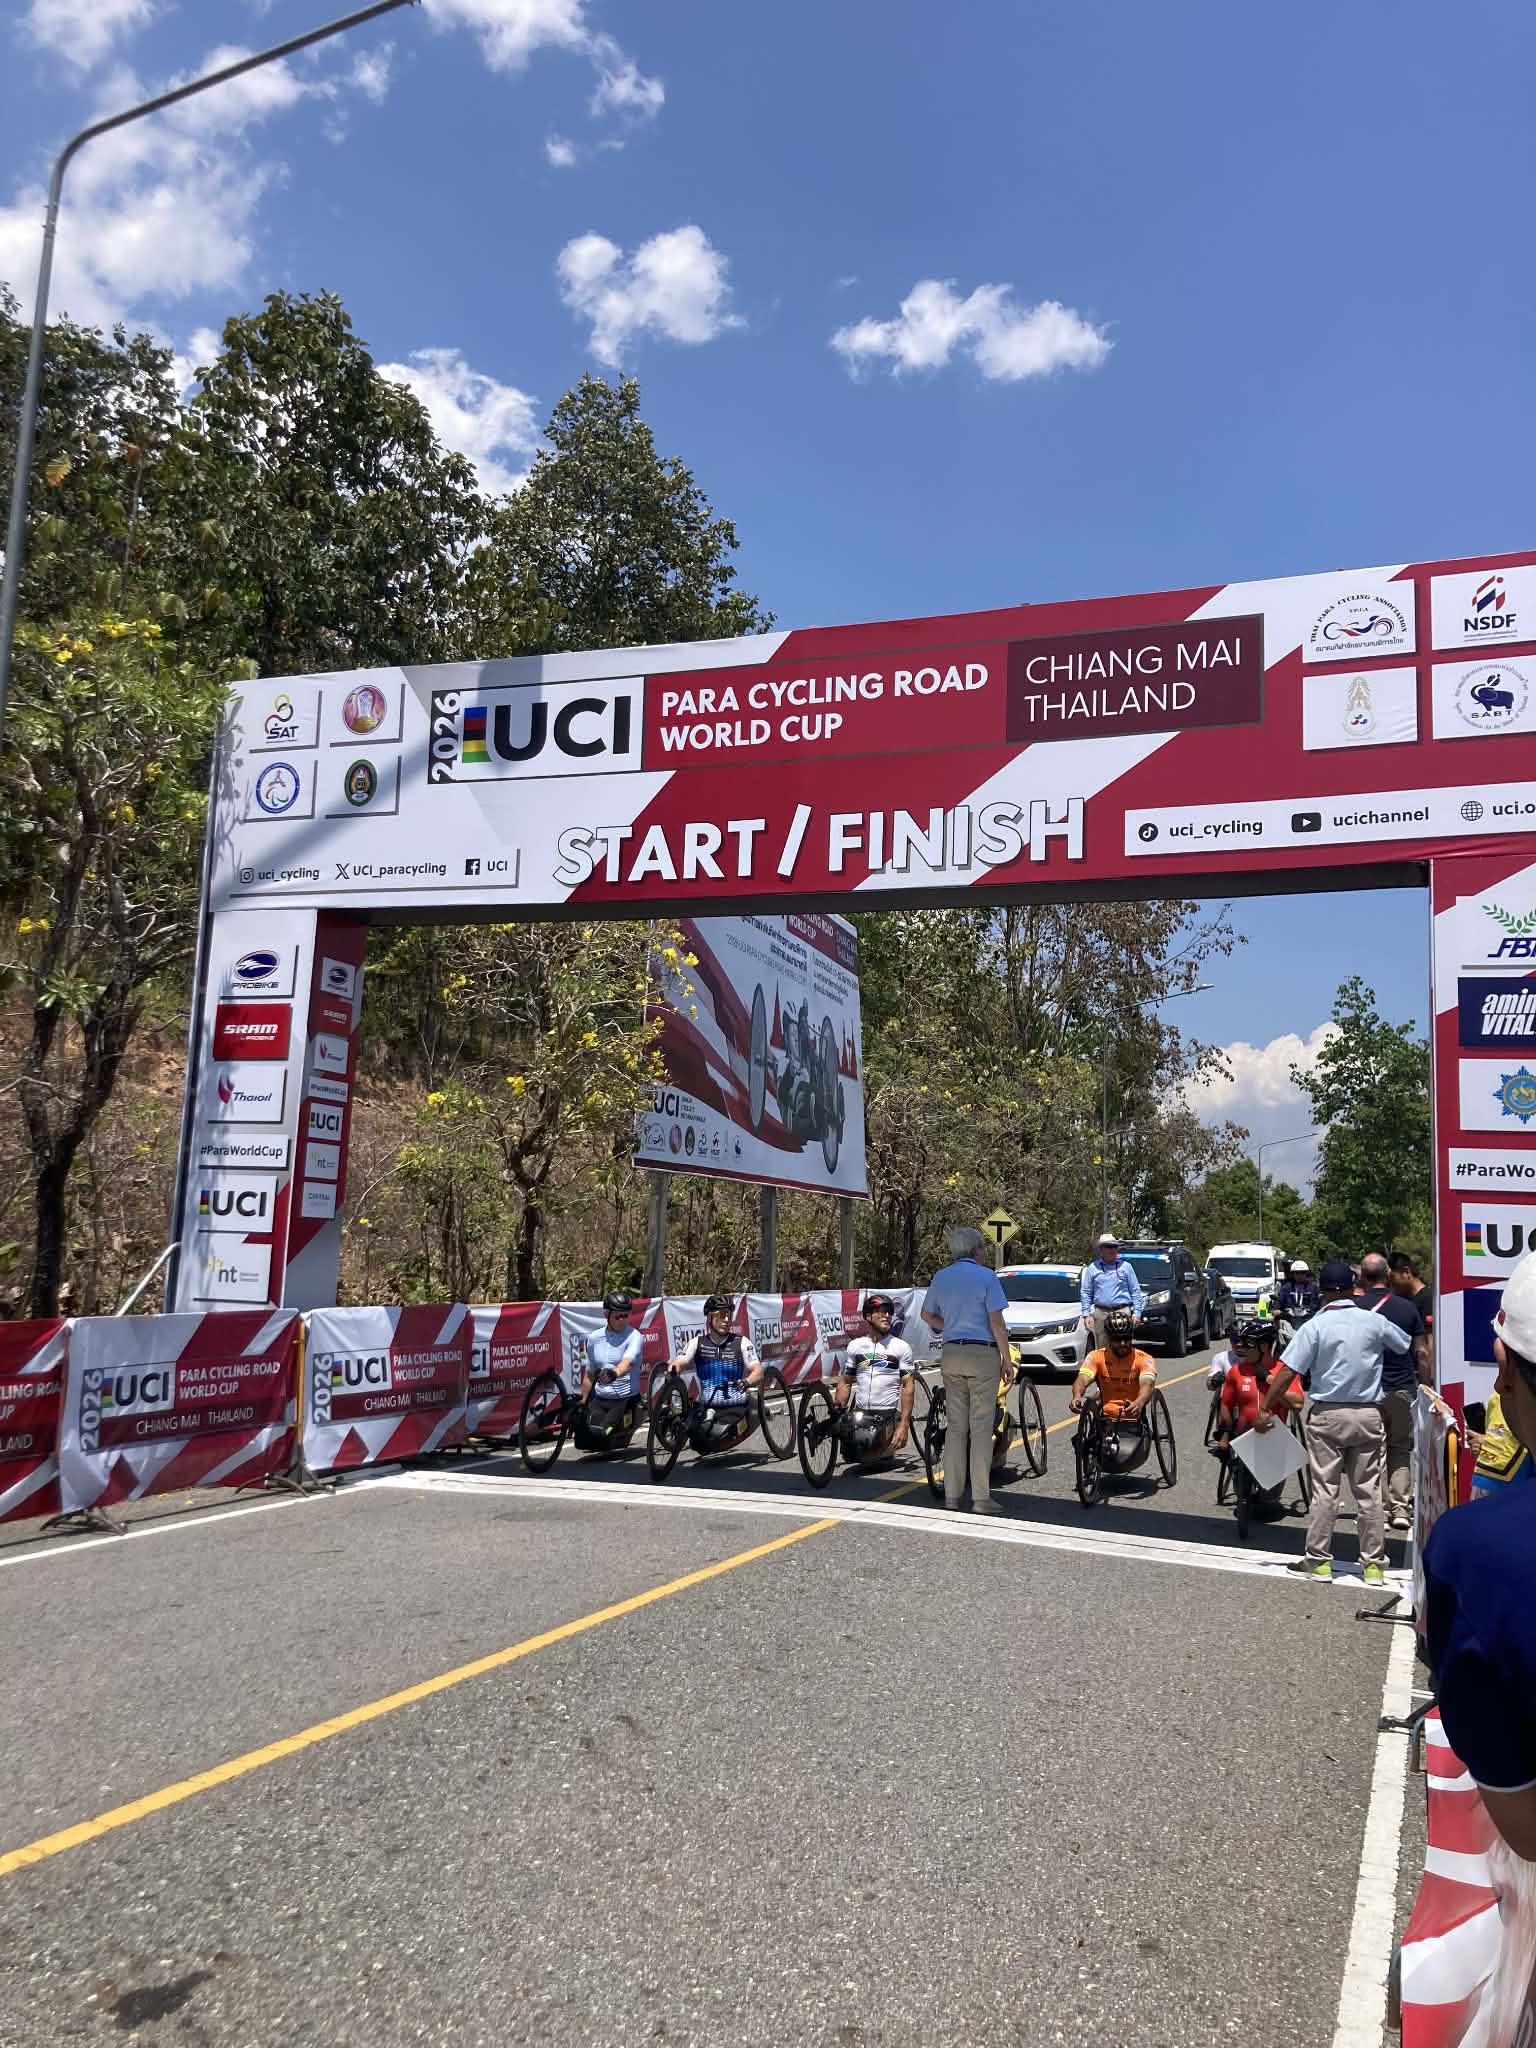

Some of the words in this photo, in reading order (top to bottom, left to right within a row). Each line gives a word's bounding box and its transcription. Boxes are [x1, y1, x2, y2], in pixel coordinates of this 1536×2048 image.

[1310, 625, 1319, 643] THAI
[1317, 605, 1335, 622] PARA
[1337, 594, 1371, 606] CYCLING
[1373, 596, 1408, 633] ASSOCIATION
[1464, 613, 1517, 632] NSDF
[1025, 645, 1163, 685] CHIANG
[1177, 637, 1242, 671] MAI
[662, 686, 740, 717] PARA
[748, 673, 884, 709] CYCLING
[894, 663, 989, 697] ROAD
[1024, 682, 1196, 722] THAILAND
[1471, 709, 1513, 719] SABT
[266, 726, 299, 740] SAT
[432, 691, 460, 782] 2026
[494, 695, 631, 761] UCI
[660, 720, 771, 752] WORLD
[780, 713, 844, 742] CUP
[1332, 806, 1429, 827] ucichannel
[1492, 801, 1536, 815] uci.o
[1169, 818, 1264, 839] uci_cycling
[553, 817, 766, 887] START
[776, 803, 813, 877] /
[828, 796, 1086, 874] FINISH
[258, 867, 320, 882] uci_cycling
[353, 862, 447, 878] UCI_paracycling
[487, 860, 508, 872] UCI
[232, 981, 280, 989] PROBIKE
[224, 1024, 279, 1034] SRAM
[316, 1113, 340, 1132] UCI
[200, 1144, 284, 1160] #ParaWorldCup
[1456, 1163, 1536, 1178] #ParaWo
[212, 1190, 268, 1218] UCI
[218, 1266, 238, 1283] nt
[764, 1322, 781, 1340] UCI
[827, 1316, 843, 1334] UCI
[393, 1354, 413, 1367] PARA
[413, 1352, 444, 1365] CYCLING
[444, 1350, 463, 1362] ROAD
[492, 1345, 509, 1357] PARA
[509, 1342, 534, 1355] CYCLING
[534, 1341, 550, 1352] ROAD
[179, 1369, 208, 1383] PARA
[210, 1365, 251, 1380] CYCLING
[252, 1361, 281, 1376] ROAD
[344, 1356, 388, 1386] UCI
[492, 1358, 516, 1370] WORLD
[516, 1356, 528, 1368] CUP
[394, 1369, 420, 1381] WORLD
[421, 1367, 436, 1378] CUP
[115, 1371, 170, 1407] UCI
[179, 1385, 217, 1400] WORLD
[219, 1381, 239, 1395] CUP
[314, 1354, 334, 1422] 2026
[364, 1395, 398, 1410] CHIANG
[398, 1393, 412, 1406] MAI
[416, 1389, 448, 1405] THAILAND
[81, 1370, 104, 1450] 2026
[136, 1416, 178, 1435] CHIANG
[181, 1413, 201, 1428] MAI
[208, 1407, 254, 1425] THAILAND
